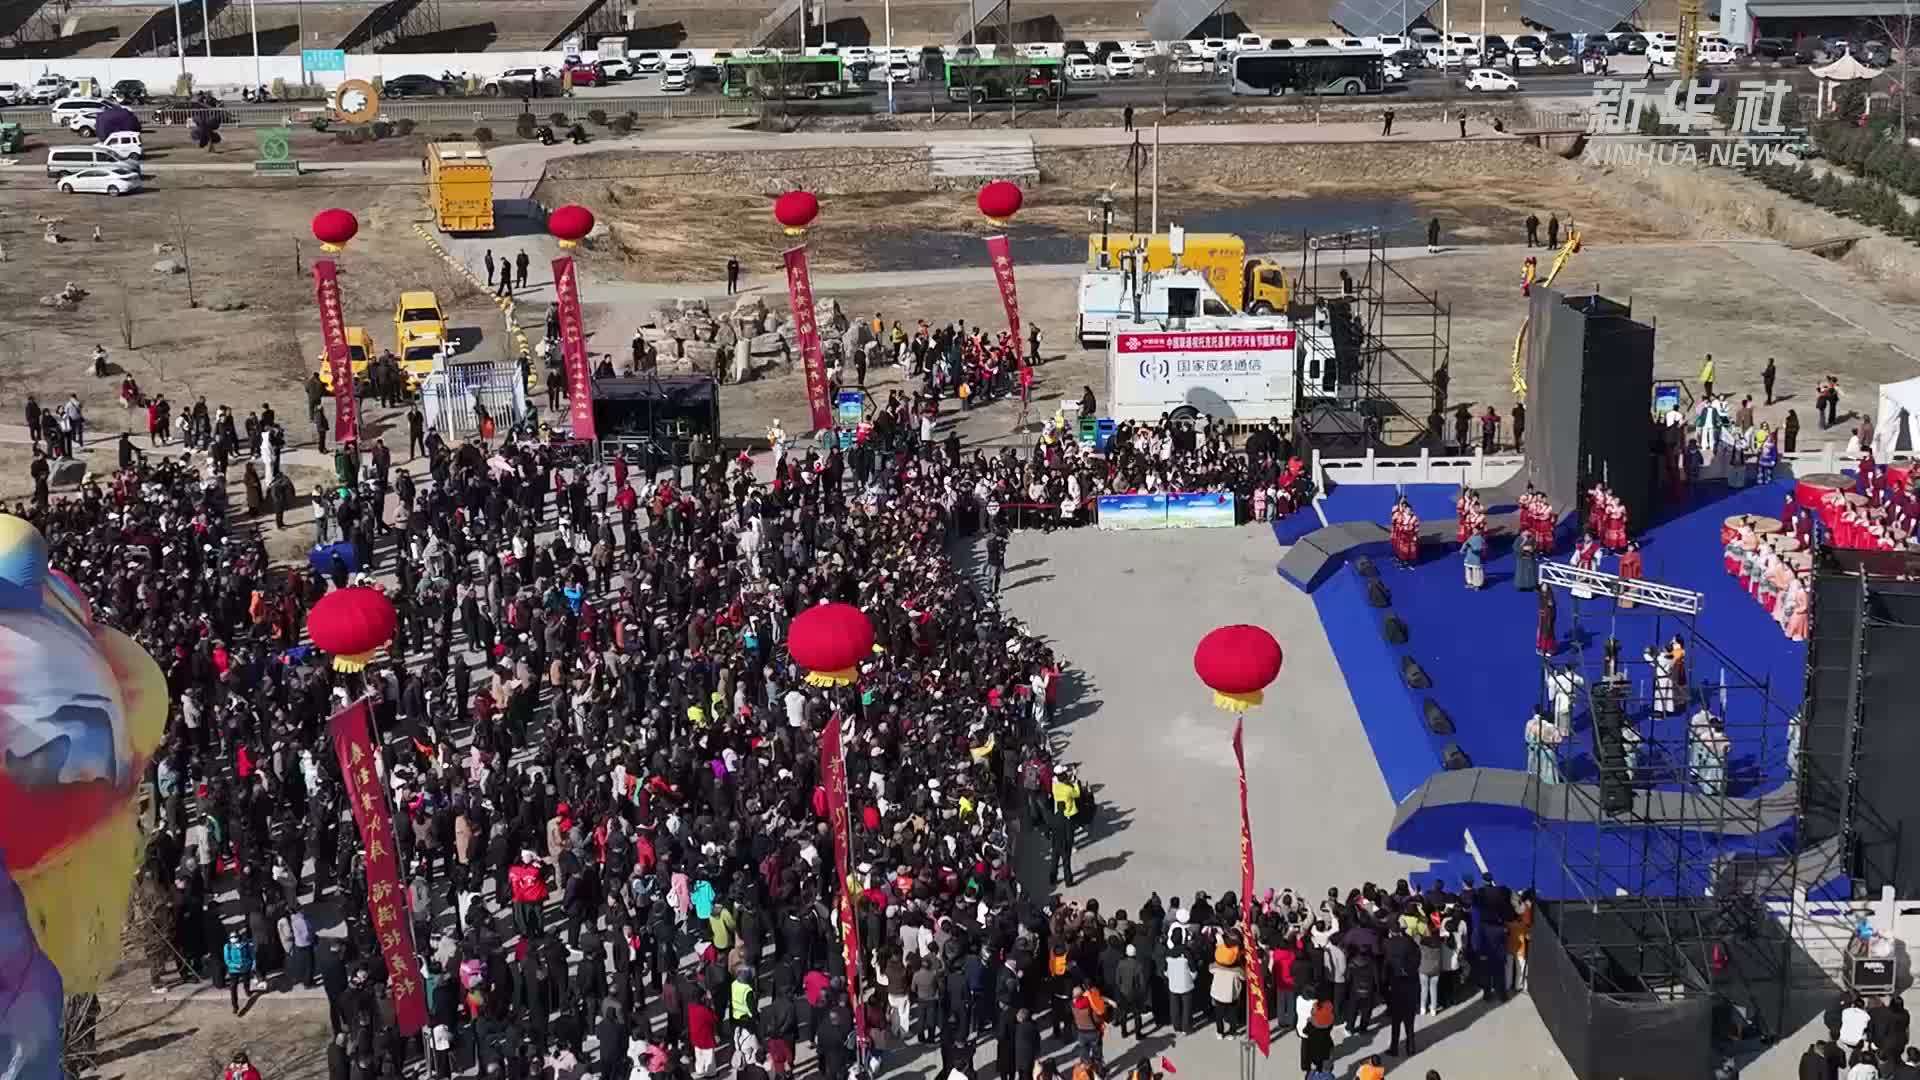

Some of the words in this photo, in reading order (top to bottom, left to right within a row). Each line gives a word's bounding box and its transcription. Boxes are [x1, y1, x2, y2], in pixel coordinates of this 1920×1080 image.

[1177, 359, 1262, 372] 国家应急通信
